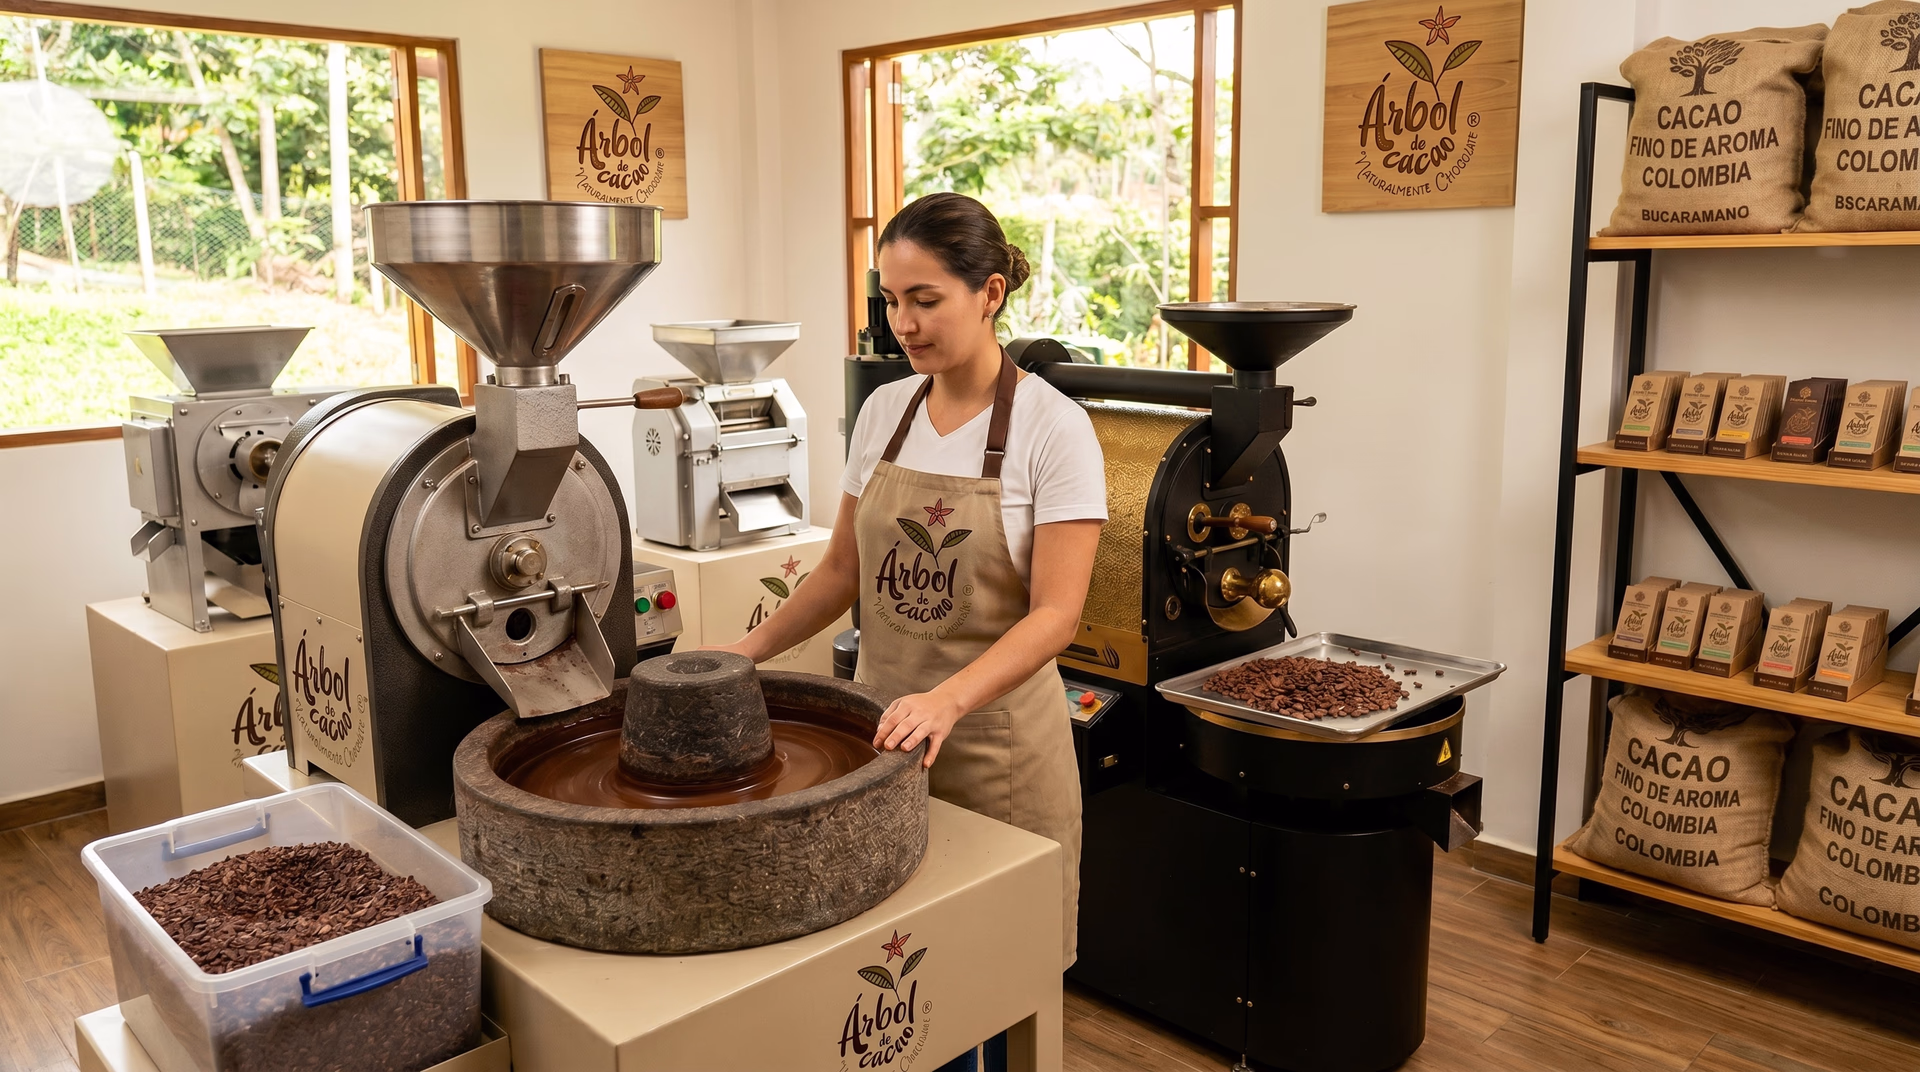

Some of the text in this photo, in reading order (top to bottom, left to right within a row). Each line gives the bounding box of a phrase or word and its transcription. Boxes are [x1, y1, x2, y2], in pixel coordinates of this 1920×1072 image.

[1358, 72, 1463, 151] Árbol
[1657, 100, 1742, 130] CACAO
[576, 109, 651, 170] Árbol
[1410, 134, 1426, 151] de
[1629, 126, 1779, 159] FINO DE AROMA
[1824, 117, 1861, 140] FINO
[1868, 117, 1899, 140] DE
[617, 160, 629, 172] de
[1382, 136, 1455, 175] cacao
[597, 163, 649, 190] cacao
[1642, 161, 1752, 189] COLOMBIA
[1641, 205, 1749, 224] BUCARAMANO
[1835, 195, 1920, 212] BSCARAM
[875, 540, 958, 601] Árbol
[917, 592, 929, 605] de
[292, 629, 351, 713] Árbol
[325, 699, 336, 717] de
[1627, 737, 1731, 783] CACAO
[1615, 762, 1741, 809] FINO DE AROMA
[1621, 796, 1718, 835] COLOMBIA
[1820, 805, 1856, 840] FINO
[1861, 825, 1889, 851] DE
[1615, 827, 1719, 868] COLOMBIA
[837, 980, 917, 1058] Árbol
[879, 1032, 891, 1047] de
